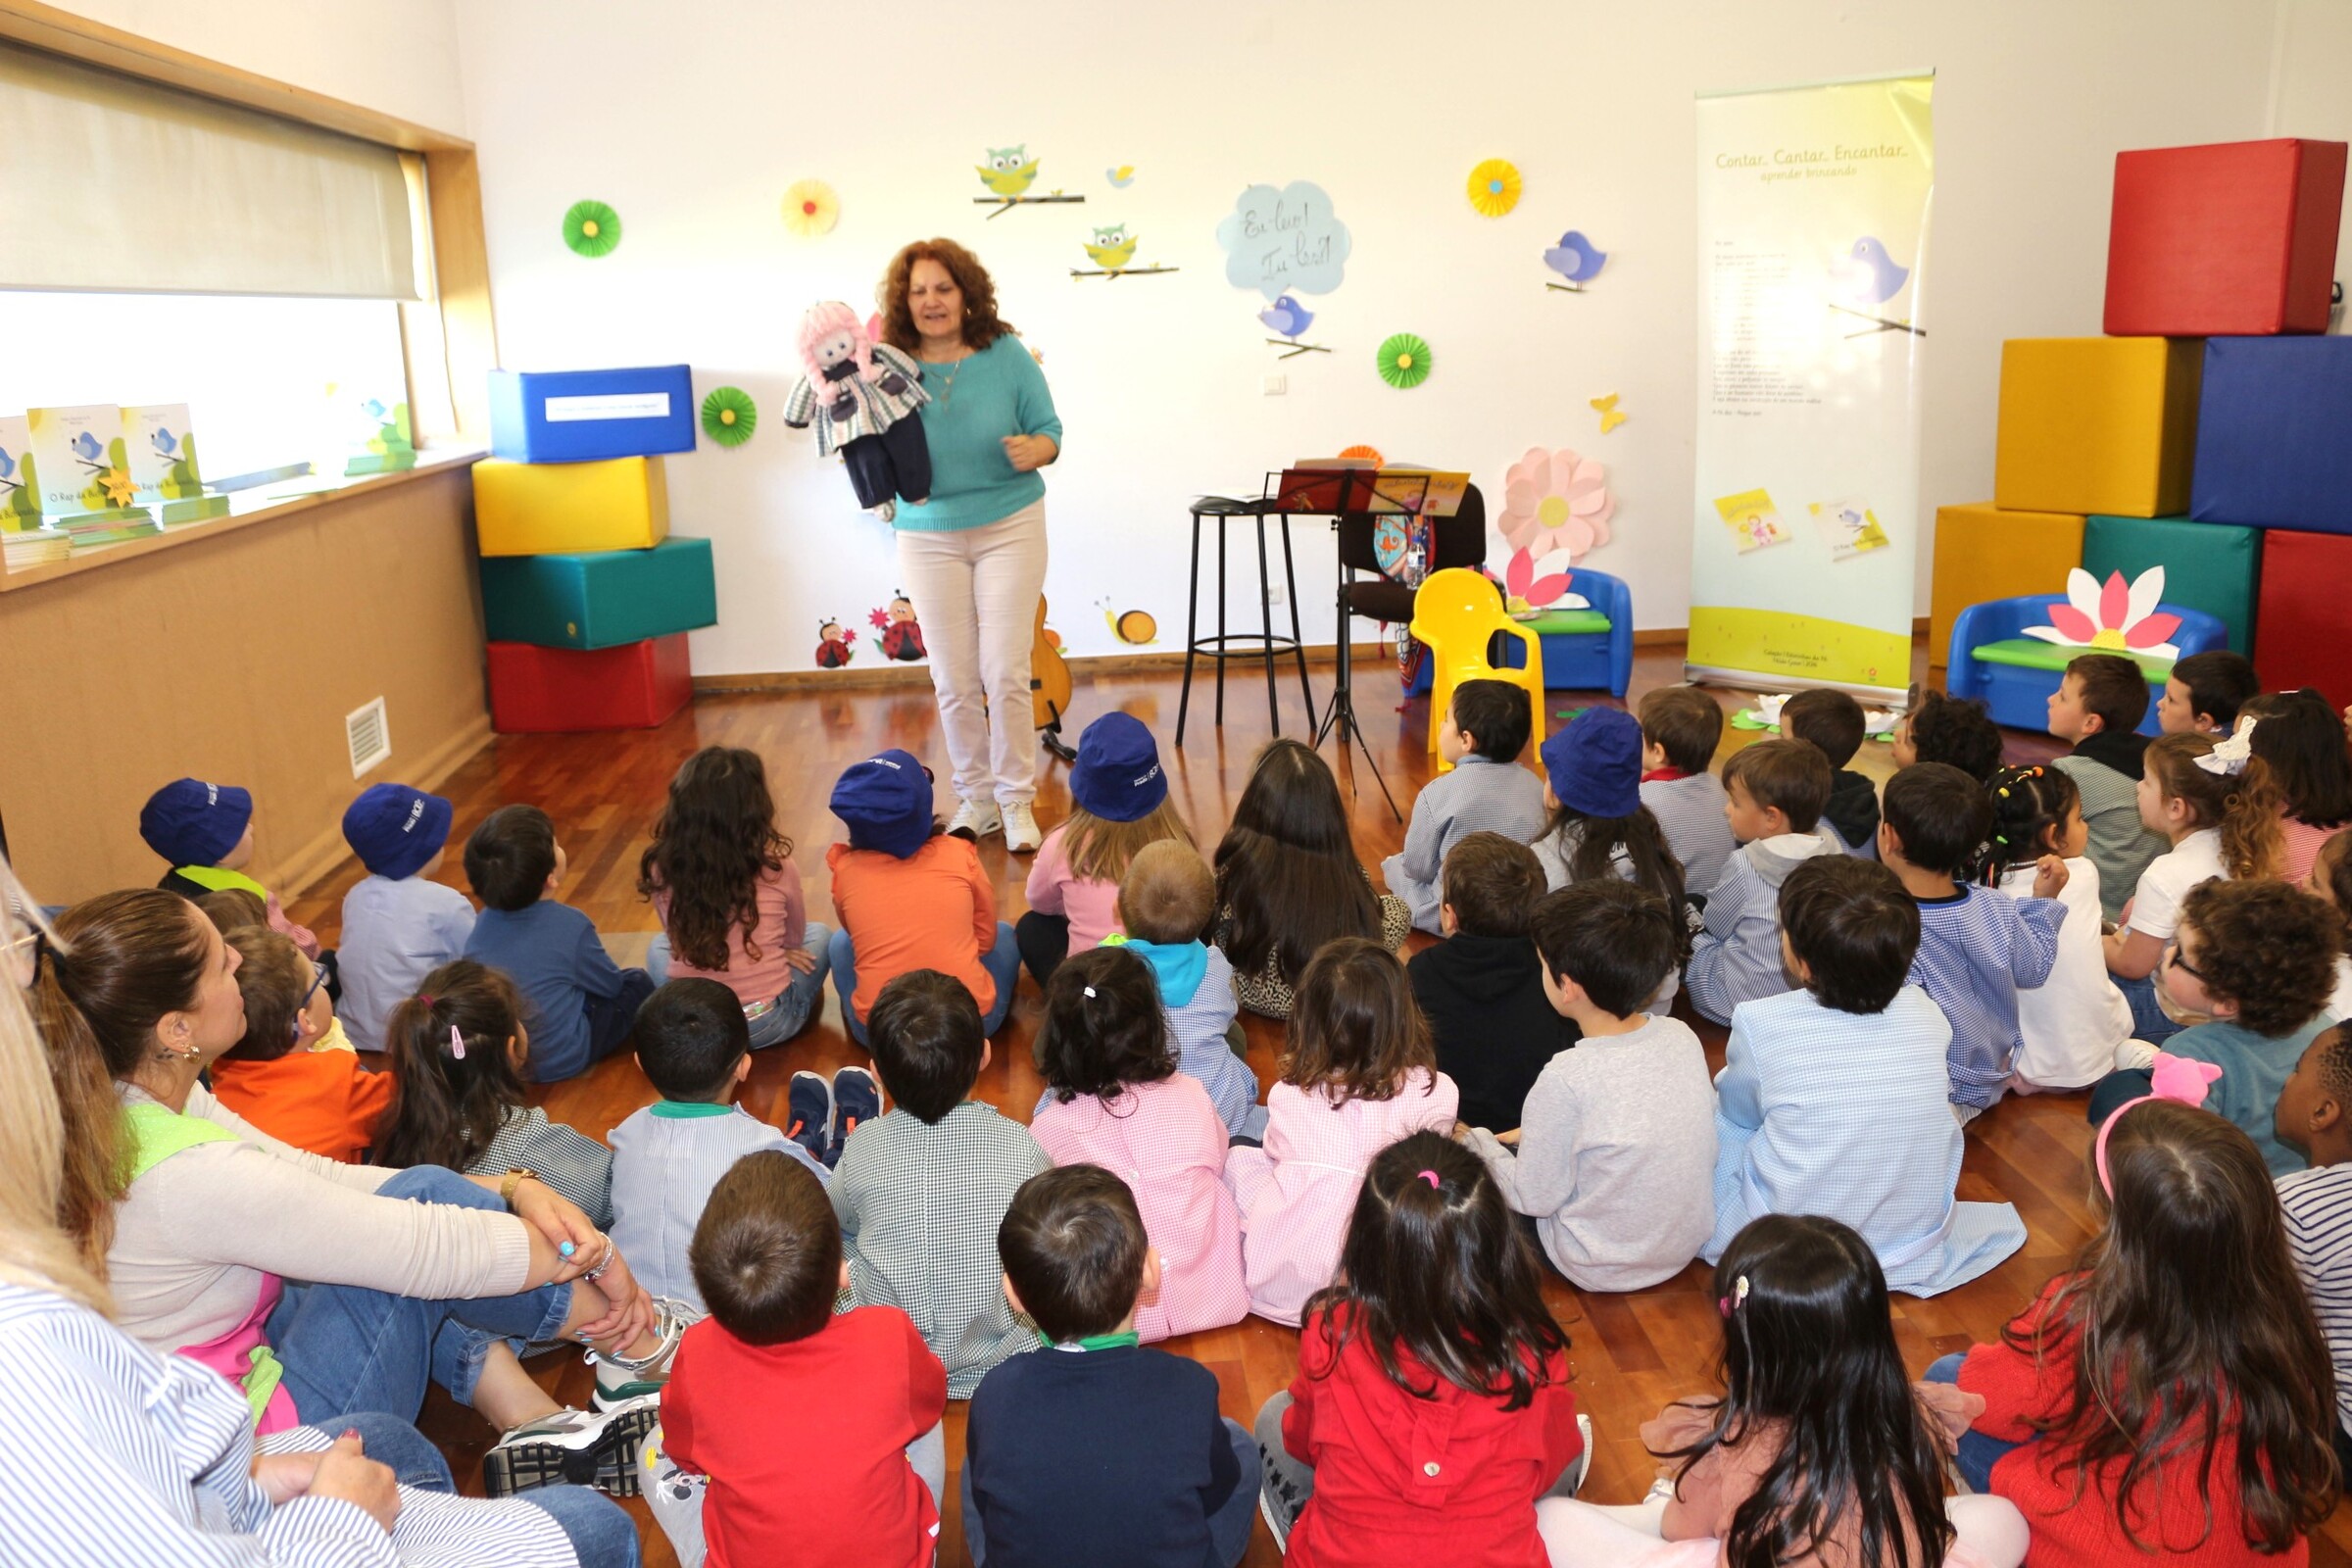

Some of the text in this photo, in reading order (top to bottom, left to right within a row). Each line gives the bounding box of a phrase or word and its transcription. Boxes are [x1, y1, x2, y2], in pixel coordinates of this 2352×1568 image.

[1760, 165, 1858, 184] aprender brincando
[1260, 246, 1289, 279] Tu
